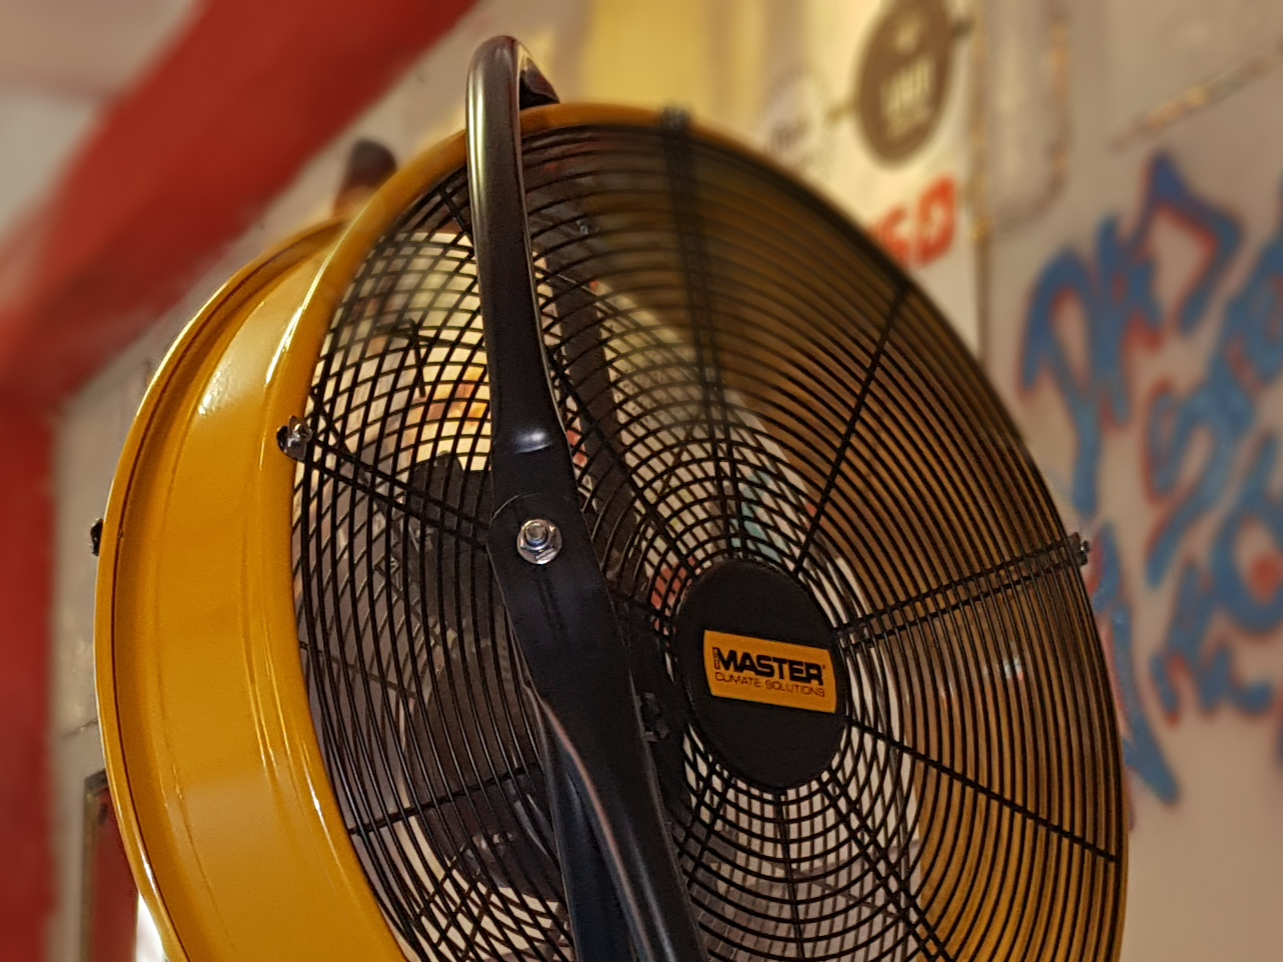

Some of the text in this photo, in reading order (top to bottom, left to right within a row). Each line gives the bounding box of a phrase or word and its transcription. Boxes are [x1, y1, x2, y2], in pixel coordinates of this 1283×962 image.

[712, 647, 824, 686] MASTER
[715, 671, 825, 697] CLIMATE SOLUTIONS
